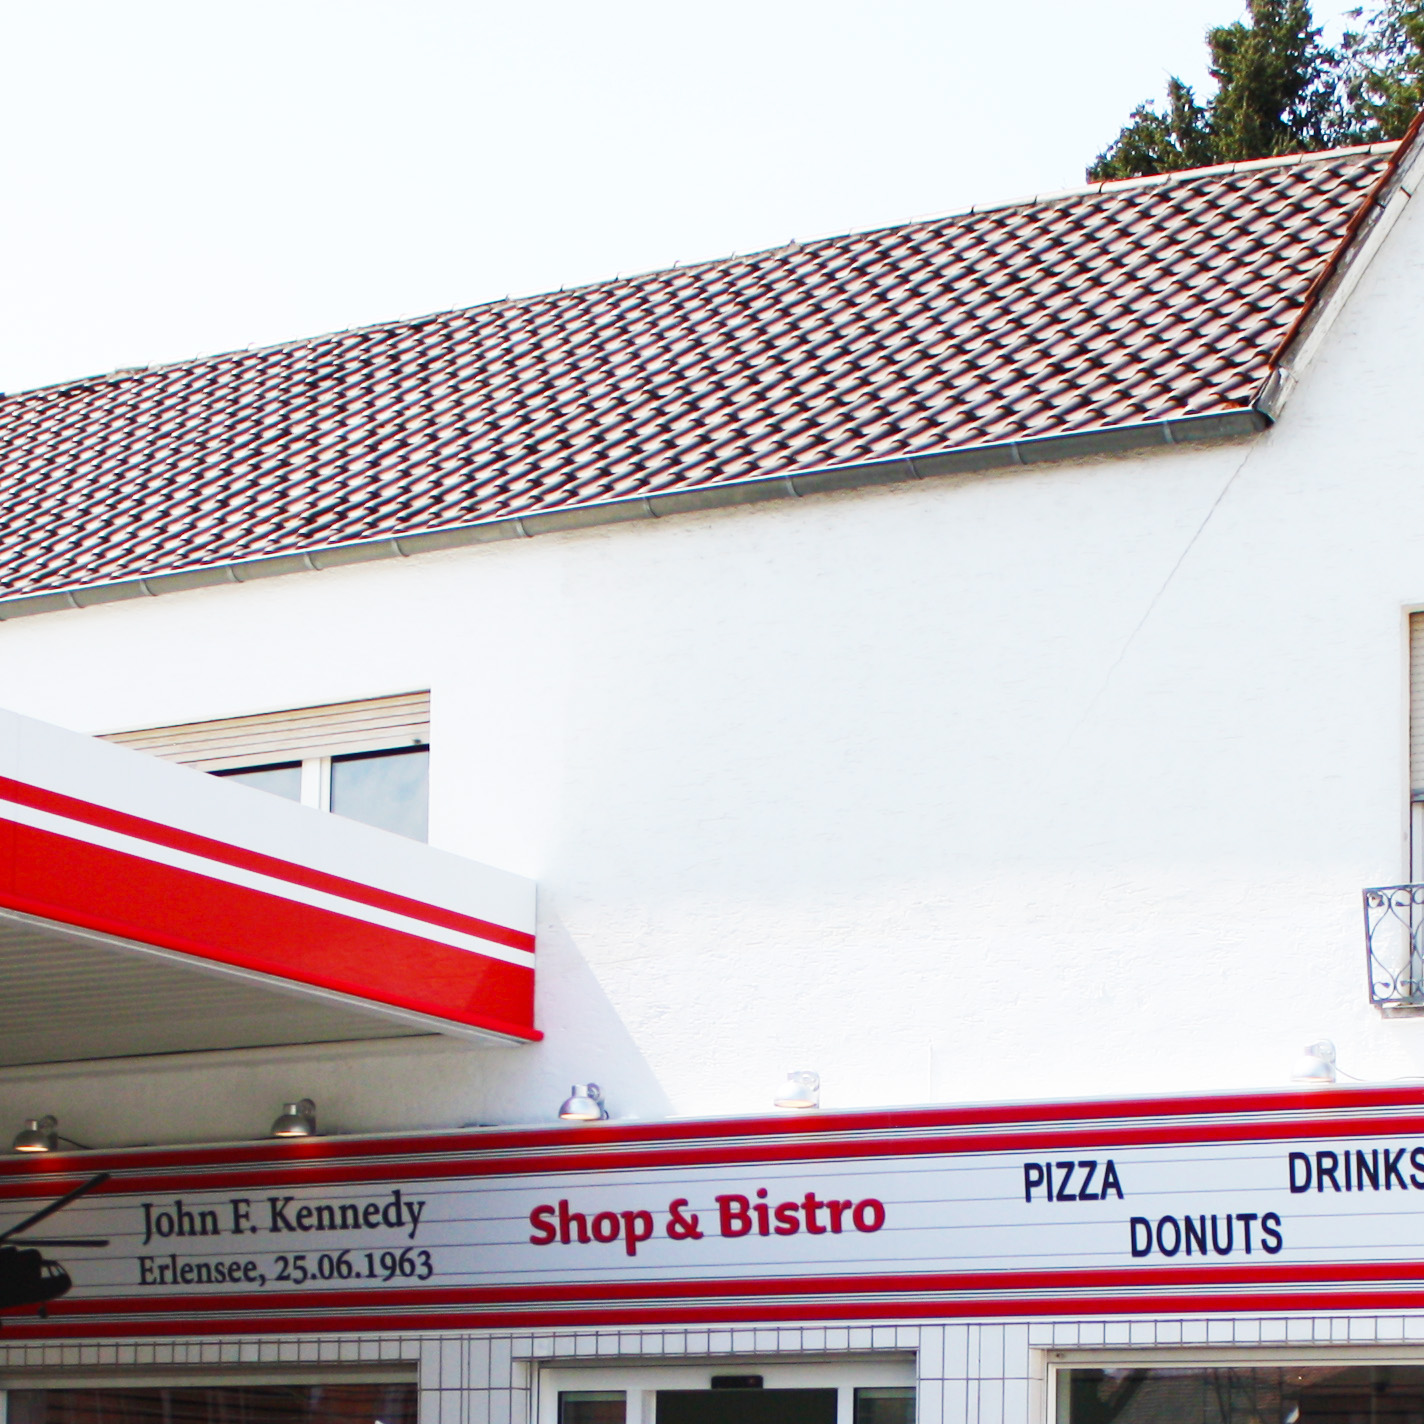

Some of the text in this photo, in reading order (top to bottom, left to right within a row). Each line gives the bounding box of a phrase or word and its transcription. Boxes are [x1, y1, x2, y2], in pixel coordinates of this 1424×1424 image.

[1023, 1159, 1124, 1203] PIZZA
[141, 1189, 427, 1247] John F. Kennedy
[529, 1188, 886, 1255] Shop & Bistro
[1129, 1211, 1283, 1258] DONUTS
[137, 1249, 434, 1287] Erlensee, 25.06.1963
